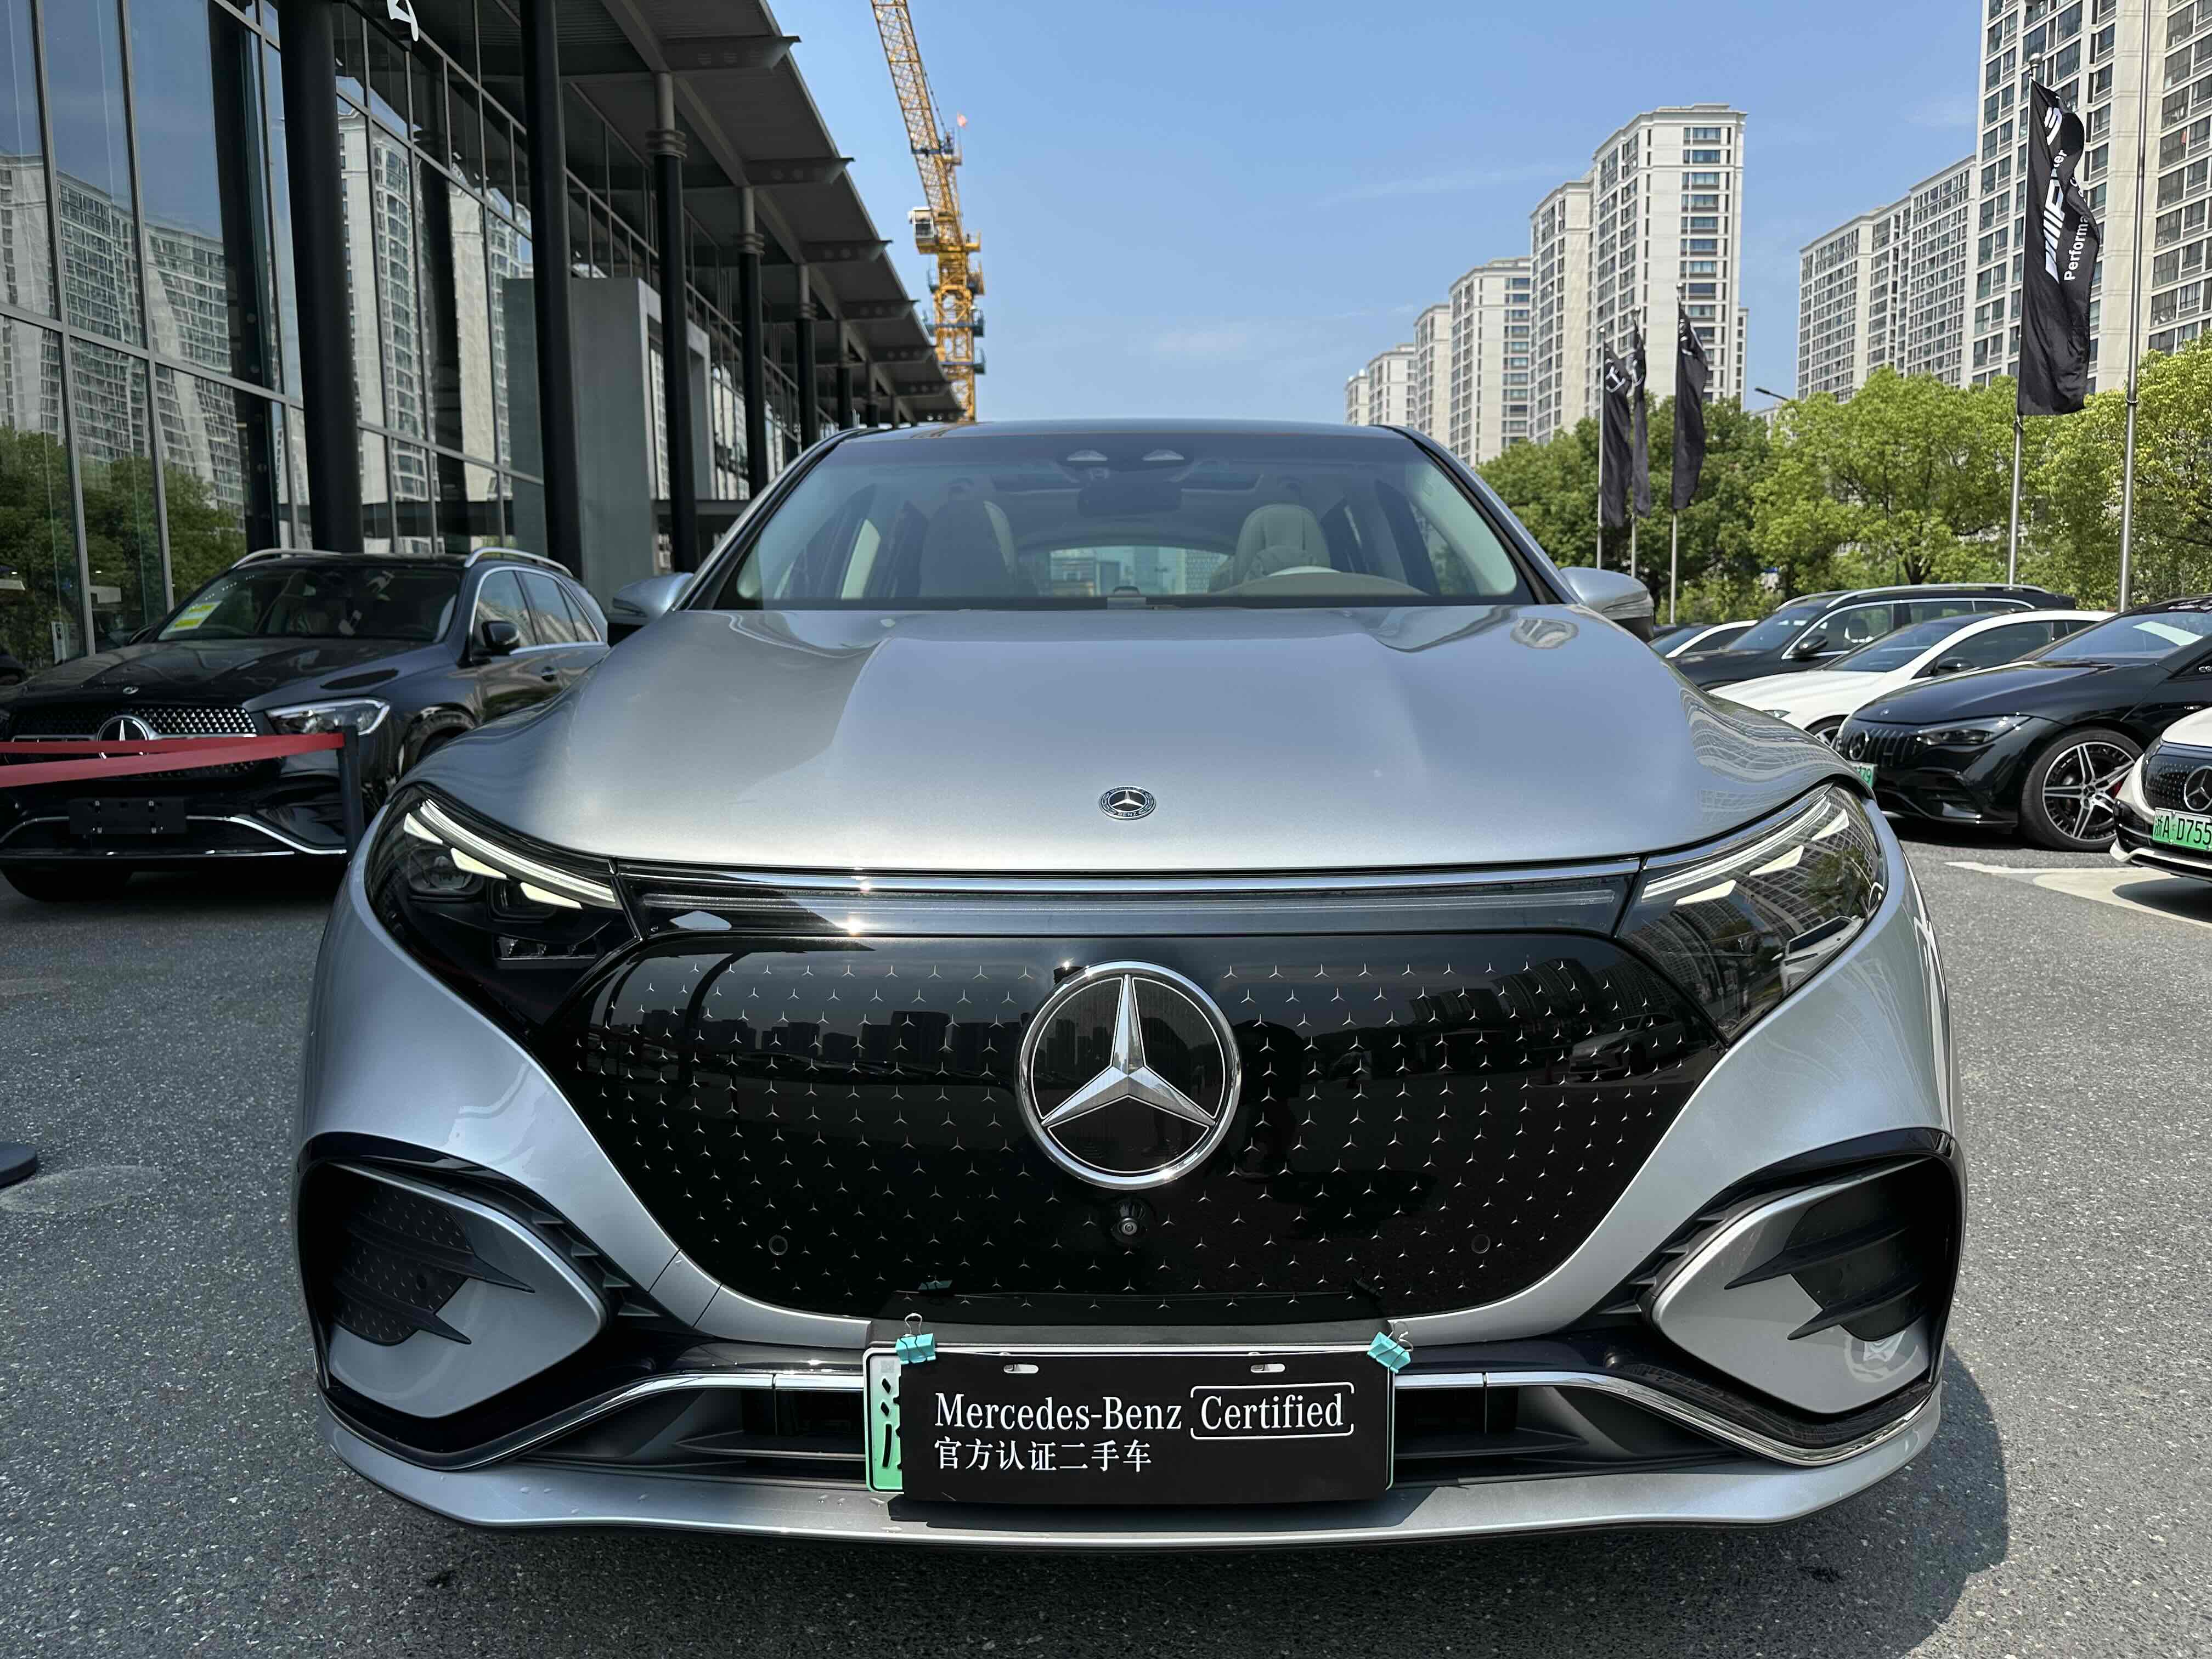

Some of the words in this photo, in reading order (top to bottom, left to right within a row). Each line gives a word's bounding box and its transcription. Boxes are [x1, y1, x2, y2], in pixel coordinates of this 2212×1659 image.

[934, 1392, 1182, 1430] Mercedes-Benz
[1201, 1392, 1344, 1430] Certified
[934, 1436, 1152, 1472] 官方认证二手车
